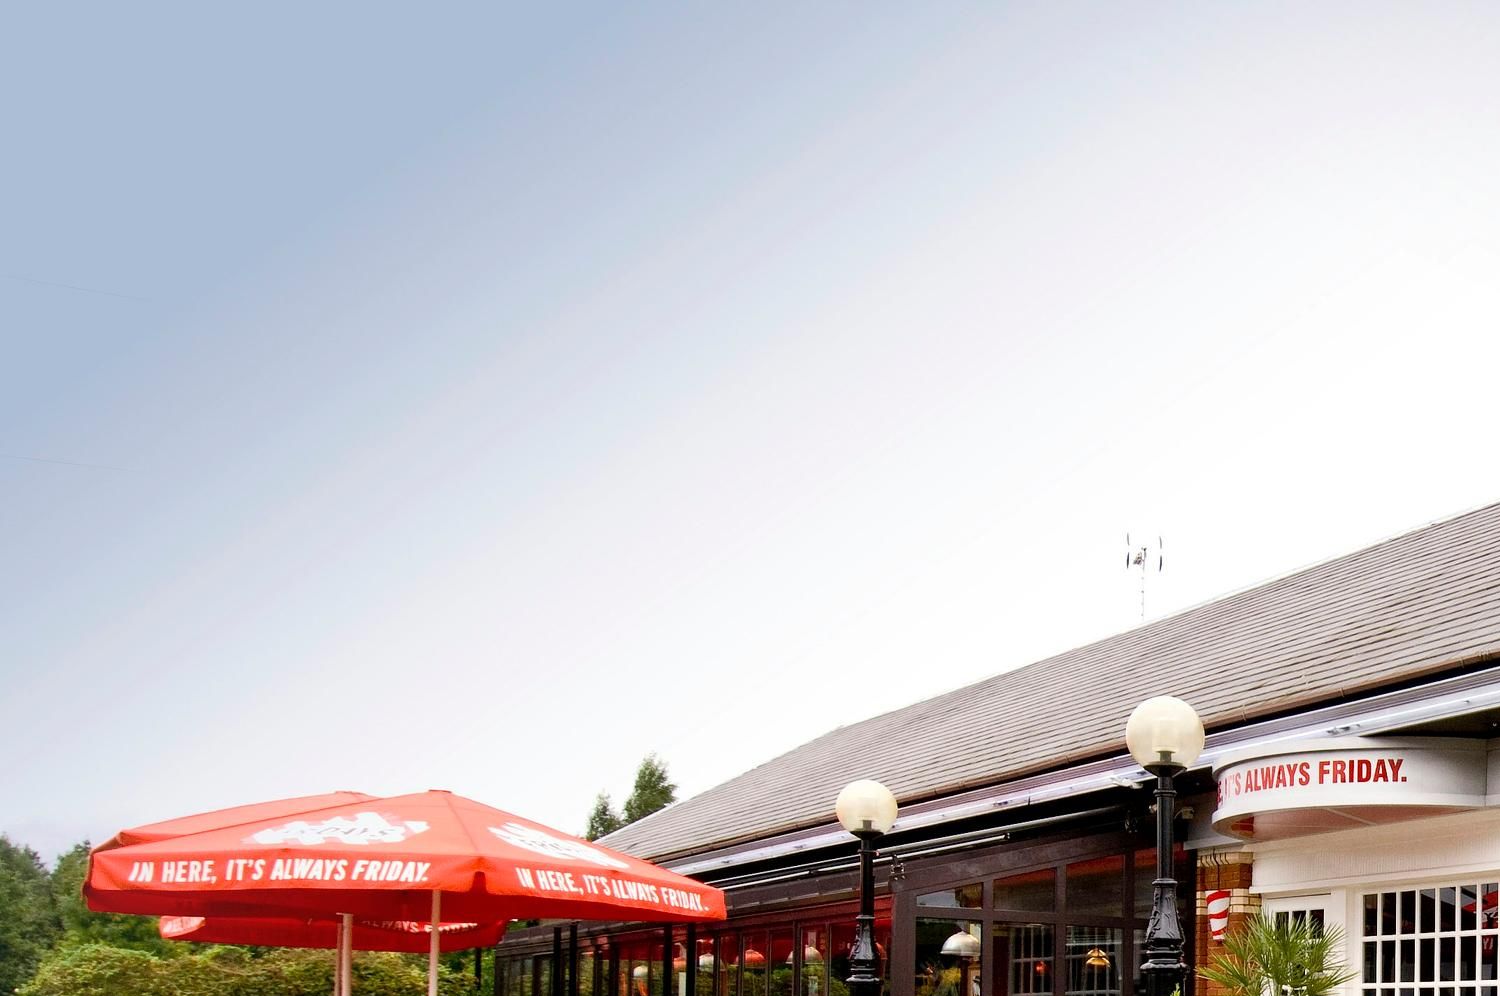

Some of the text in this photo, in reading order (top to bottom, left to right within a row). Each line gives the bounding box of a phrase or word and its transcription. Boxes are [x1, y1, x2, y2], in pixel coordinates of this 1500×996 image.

[1224, 772, 1241, 800] IT'S
[1245, 762, 1310, 793] ALWAYS
[1318, 758, 1407, 785] FRIDAY.
[128, 858, 430, 885] IN HERE, IT'S ALWAYS FRIDAY.
[515, 867, 710, 912] IN HERE, IT'S ALWAYS FRIDAY.
